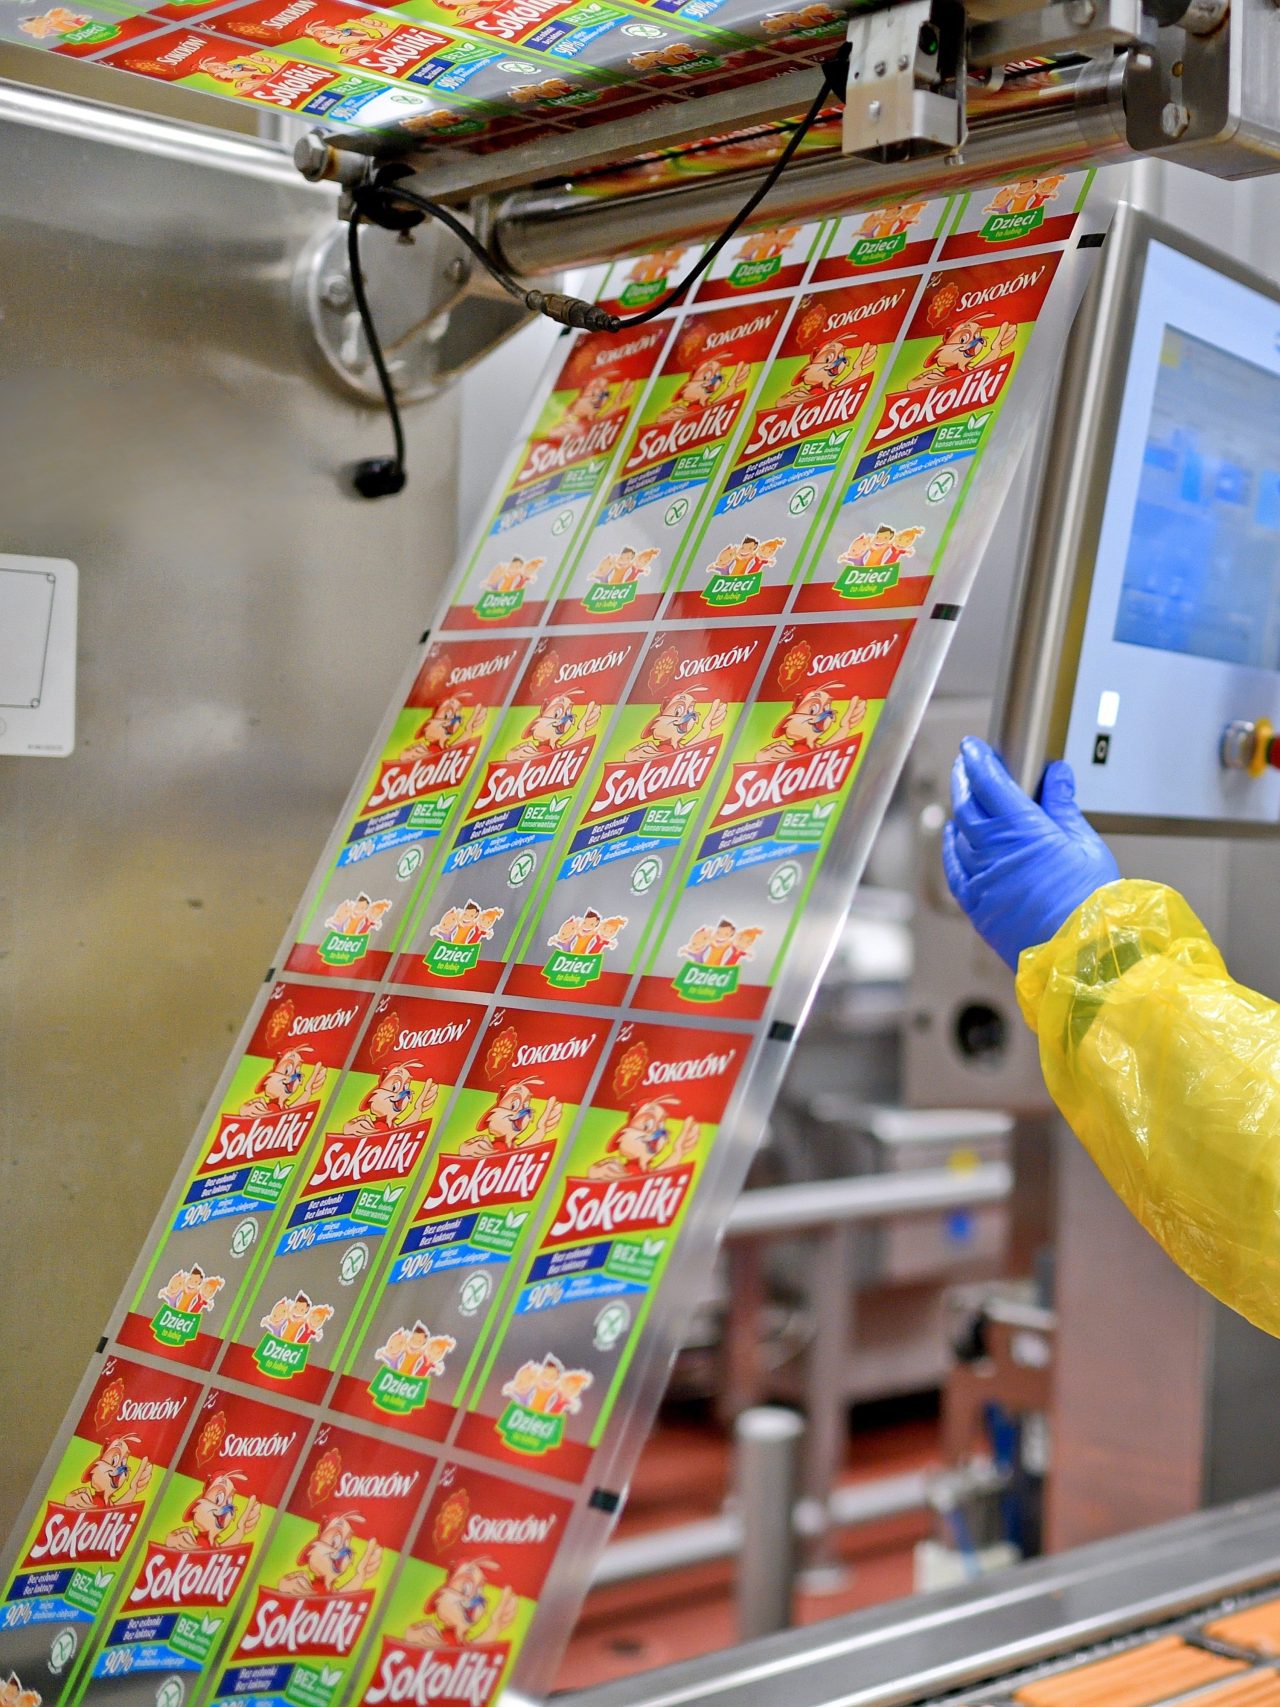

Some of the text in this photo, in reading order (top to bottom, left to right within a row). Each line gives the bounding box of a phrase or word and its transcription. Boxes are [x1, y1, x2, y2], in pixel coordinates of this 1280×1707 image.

[359, 29, 448, 73] Sokoliki
[253, 64, 335, 106] Sokoliki
[990, 211, 1037, 232] Dzieci
[857, 236, 901, 256] Dzieci
[957, 266, 1045, 311] SOKOŁÓW
[824, 288, 906, 332] SOKOŁÓW
[875, 364, 1007, 439] Sokoliki
[745, 383, 867, 454] Sokoliki
[627, 401, 740, 468] Sokoliki
[938, 427, 965, 440] BEZ
[519, 416, 623, 480] Sokoliki
[801, 443, 826, 455] BEZ
[678, 457, 701, 469] BEZ
[723, 482, 758, 511] 90%
[854, 468, 892, 499] 90%
[712, 577, 756, 592] Dzieci
[845, 568, 893, 584] Dzieci
[591, 586, 632, 600] Dzieci
[556, 646, 631, 683] SOKOŁÓW
[676, 641, 758, 680] SOKOŁÓW
[808, 635, 898, 676] SOKOŁÓW
[369, 747, 475, 806] Sokoliki
[475, 747, 589, 809] Sokoliki
[591, 747, 715, 813] Sokoliki
[721, 747, 855, 816] Sokoliki
[524, 808, 548, 819] BEZ
[647, 811, 672, 822] BEZ
[783, 814, 810, 826] BEZ
[451, 842, 484, 870] 90%
[567, 847, 603, 876] 90%
[327, 937, 364, 952] Dzieci
[434, 946, 474, 962] Dzieci
[552, 957, 596, 974] Dzieci
[684, 968, 732, 986] Dzieci
[289, 1007, 358, 1036] SOKOŁÓW
[395, 1021, 470, 1051] SOKOŁÓW
[513, 1035, 595, 1067] SOKOŁÓW
[208, 1112, 313, 1164] Sokoliki
[310, 1132, 425, 1186] Sokoliki
[251, 1171, 272, 1185] BEZ
[424, 1153, 549, 1210] Sokoliki
[358, 1193, 382, 1208] BEZ
[552, 1176, 688, 1236] Sokoliki
[283, 1225, 318, 1253] 90%
[478, 1217, 504, 1234] BEZ
[160, 1311, 196, 1335] Dzieci
[263, 1341, 303, 1366] Dzieci
[379, 1374, 423, 1400] Dzieci
[118, 1397, 186, 1421] SOKOŁÓW
[509, 1409, 557, 1437] Dzieci
[221, 1432, 296, 1457] SOKOŁÓW
[336, 1469, 420, 1496] SOKOŁÓW
[32, 1511, 137, 1558] Sokoliki
[465, 1516, 557, 1543] SOKOŁÓW
[72, 1573, 93, 1592] BEZ
[131, 1552, 246, 1602] Sokoliki
[177, 1618, 200, 1639] BEZ
[242, 1598, 367, 1652] Sokoliki
[293, 1669, 318, 1691] BEZ
[360, 1649, 505, 1707] Sokoliki
